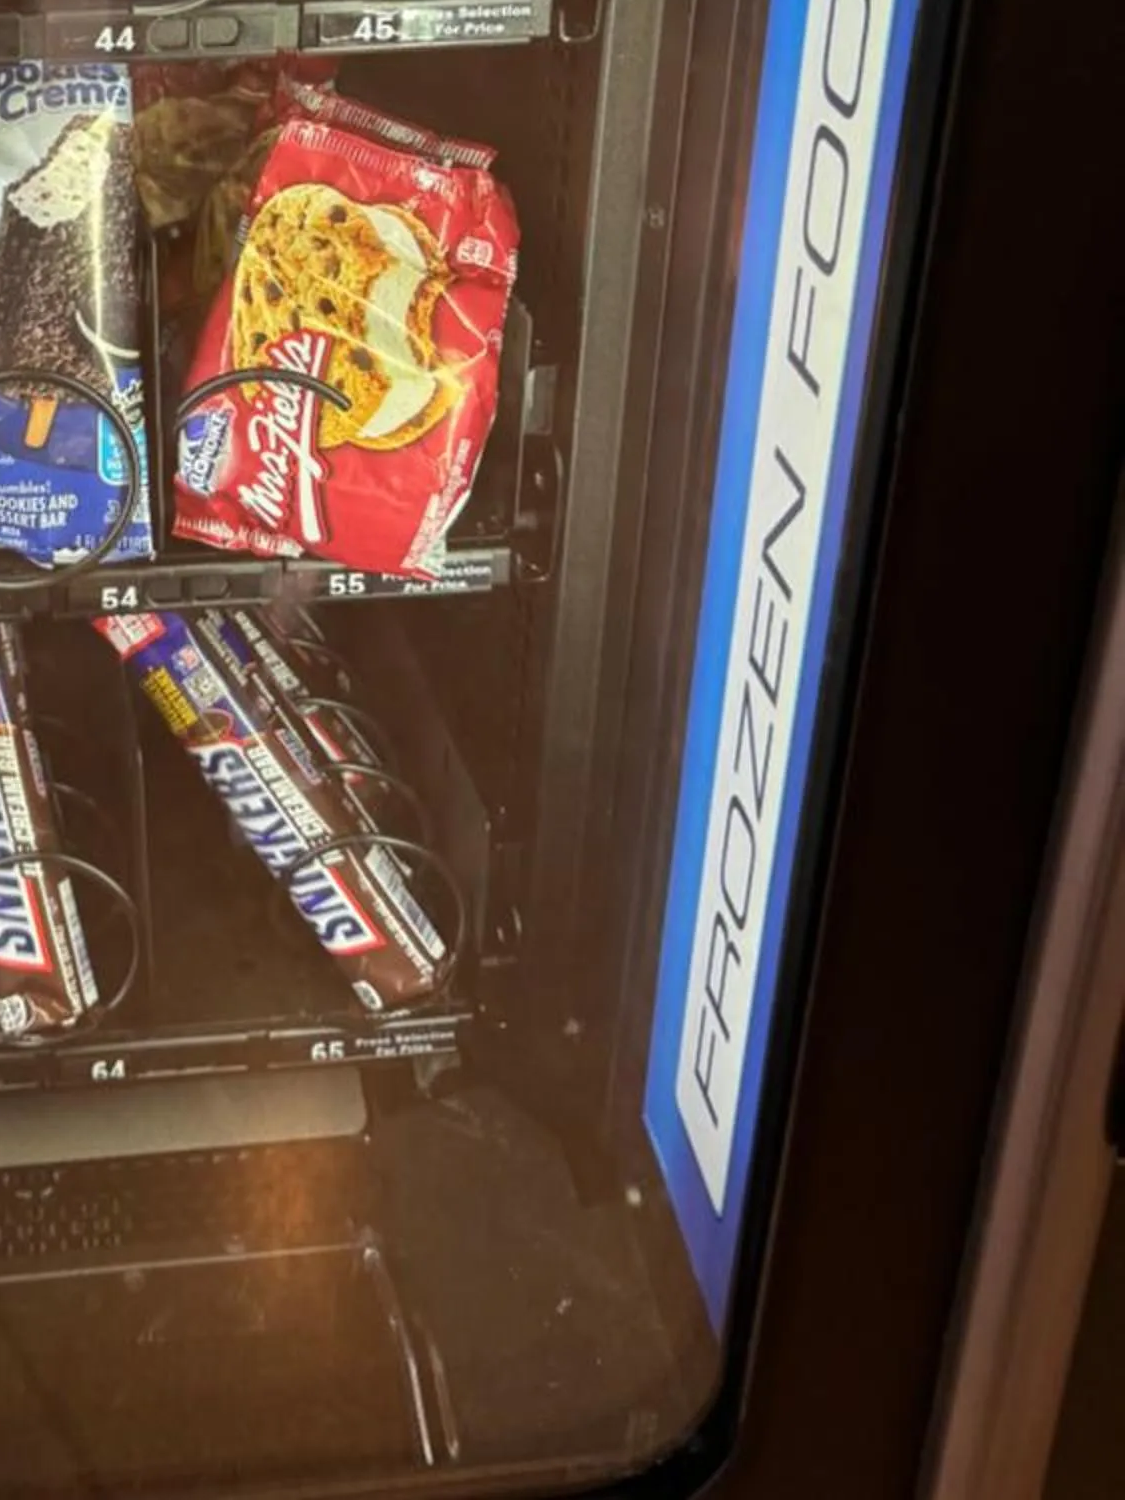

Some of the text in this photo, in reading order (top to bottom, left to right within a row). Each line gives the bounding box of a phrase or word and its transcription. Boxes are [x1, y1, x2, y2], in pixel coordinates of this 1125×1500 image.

[353, 16, 395, 41] 45
[457, 4, 532, 18] Selection
[463, 21, 506, 35] Price
[94, 27, 137, 52] 44
[48, 493, 79, 510] AND
[40, 512, 68, 530] BAR
[329, 572, 366, 596] 55
[100, 587, 138, 609] 54
[245, 746, 326, 838] CREAM BAR
[692, 445, 807, 1129] FROZEN
[198, 746, 365, 953] SNICKERS
[310, 1040, 345, 1061] 65
[395, 1031, 455, 1044] Selection
[91, 1060, 126, 1081] 64
